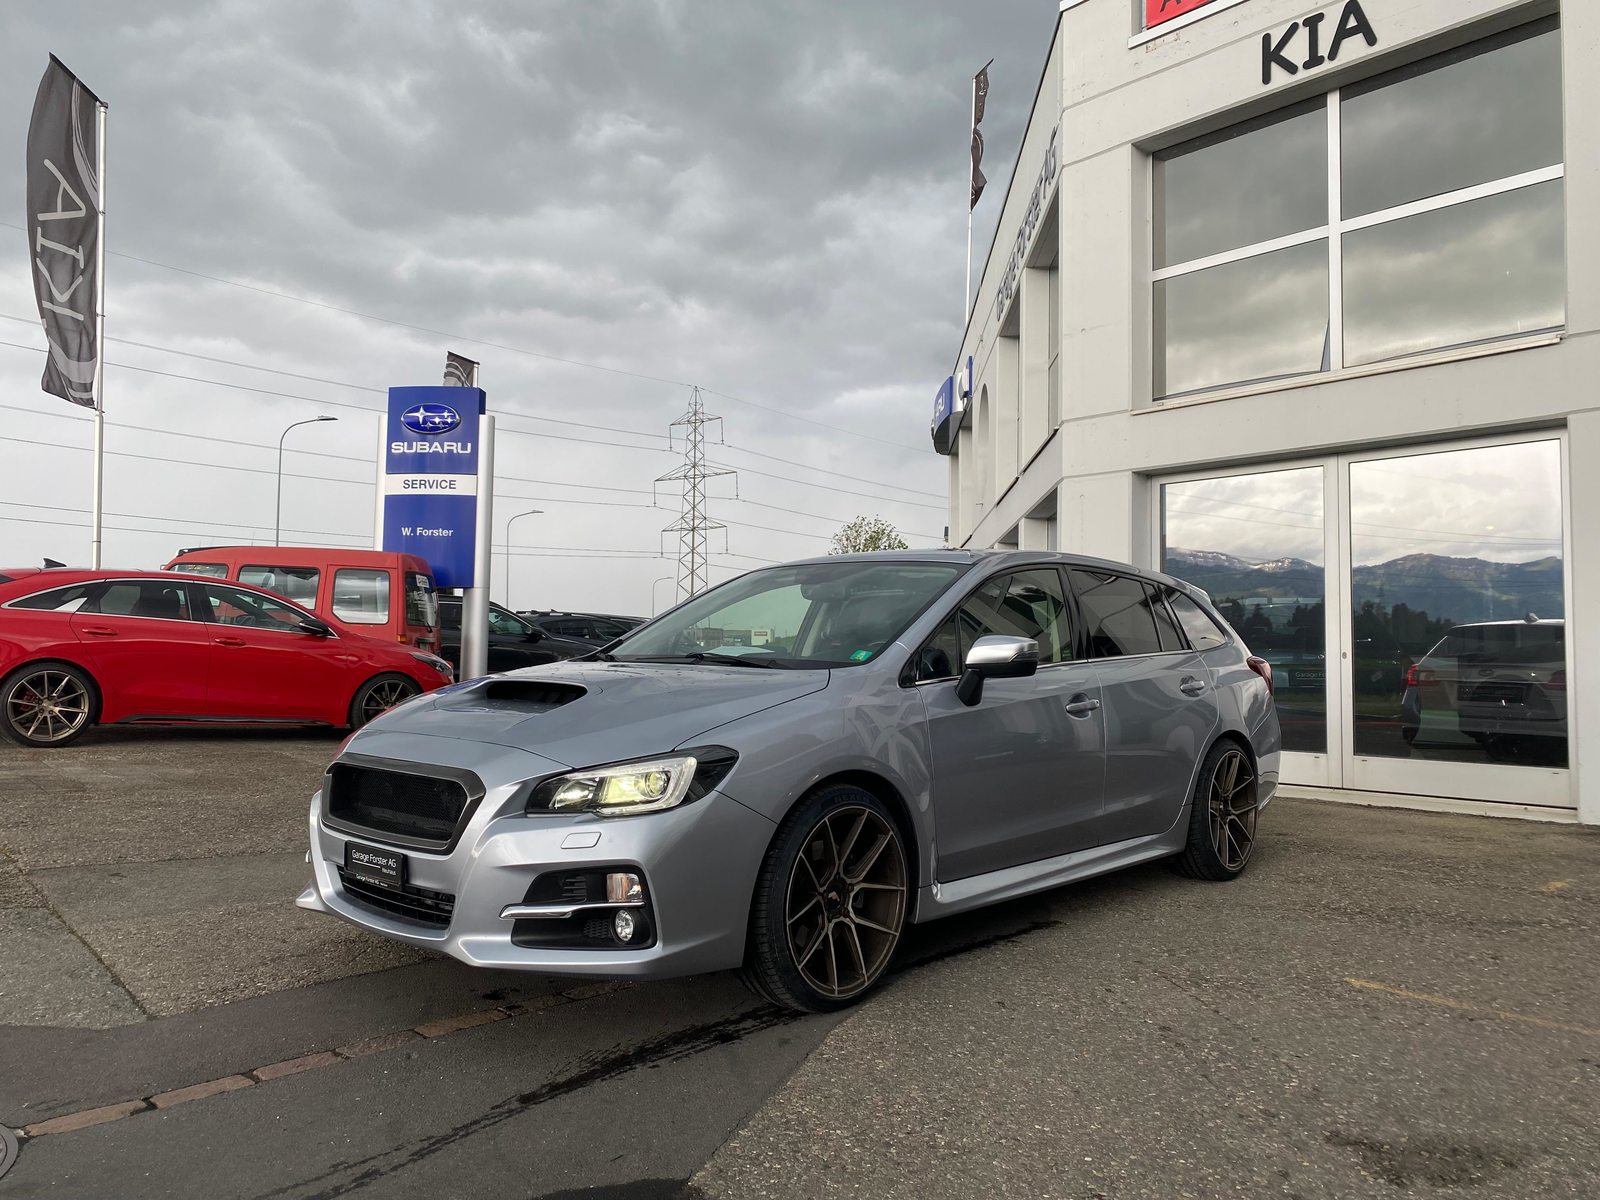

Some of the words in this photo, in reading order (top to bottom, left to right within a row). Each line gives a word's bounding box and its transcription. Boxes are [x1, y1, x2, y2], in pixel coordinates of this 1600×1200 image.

[1262, 0, 1377, 84] KIA
[391, 441, 471, 454] SUBARU
[402, 479, 457, 490] SERVICE
[401, 528, 414, 536] W.
[416, 527, 454, 537] Forster
[352, 850, 369, 862] Garage
[370, 854, 387, 865] Forster
[388, 858, 396, 867] AG
